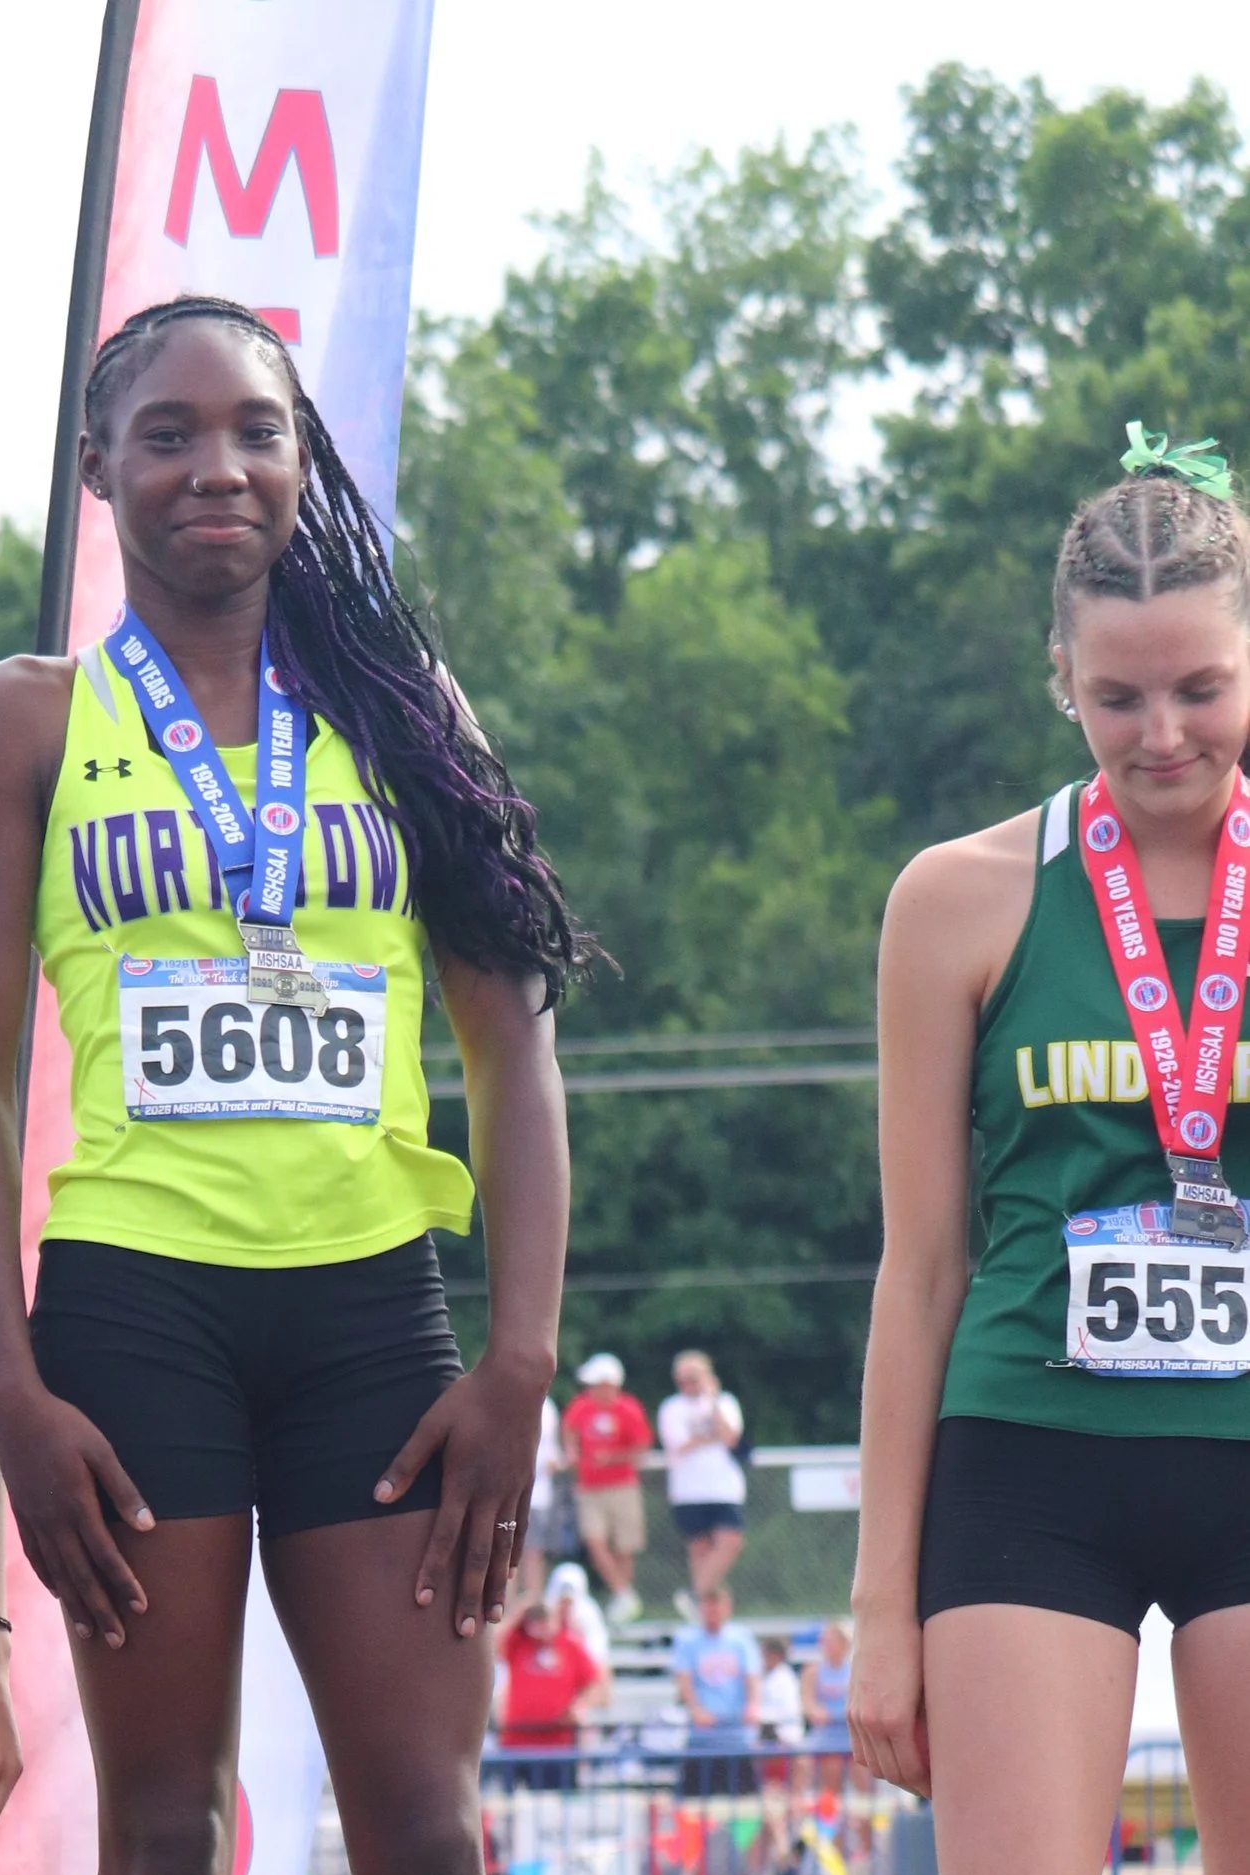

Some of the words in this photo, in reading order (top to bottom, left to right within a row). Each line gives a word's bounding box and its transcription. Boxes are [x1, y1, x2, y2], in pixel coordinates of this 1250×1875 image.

[119, 634, 146, 667] 100
[135, 657, 176, 711] YEARS
[270, 709, 294, 757] YEARS
[270, 758, 293, 789] 100
[188, 761, 246, 846] 1926-2026
[260, 847, 290, 916] MSHSAA
[1103, 864, 1131, 901] 100
[1220, 863, 1247, 921] YEARS
[1113, 900, 1148, 960] YEARS
[1214, 922, 1240, 958] 100
[168, 974, 184, 984] The
[211, 971, 238, 983] Track
[256, 952, 303, 970] MSHSAA
[141, 1002, 366, 1089] 5608
[1194, 1025, 1225, 1095] MSHSAA
[145, 1106, 172, 1116] 2026
[173, 1103, 220, 1115] MSHSAA
[221, 1101, 250, 1112] Track
[251, 1101, 271, 1111] and
[272, 1101, 296, 1112] Field
[296, 1102, 366, 1119] Championships
[1183, 1184, 1226, 1204] MSHSAA
[1107, 1215, 1133, 1227] 1926
[1114, 1233, 1130, 1243] The
[1086, 1263, 1249, 1346] 555
[1086, 1360, 1113, 1370] 2026
[1114, 1360, 1161, 1370] MSHSAA
[1162, 1361, 1190, 1370] Track
[1191, 1361, 1211, 1371] and
[1212, 1361, 1236, 1371] Field
